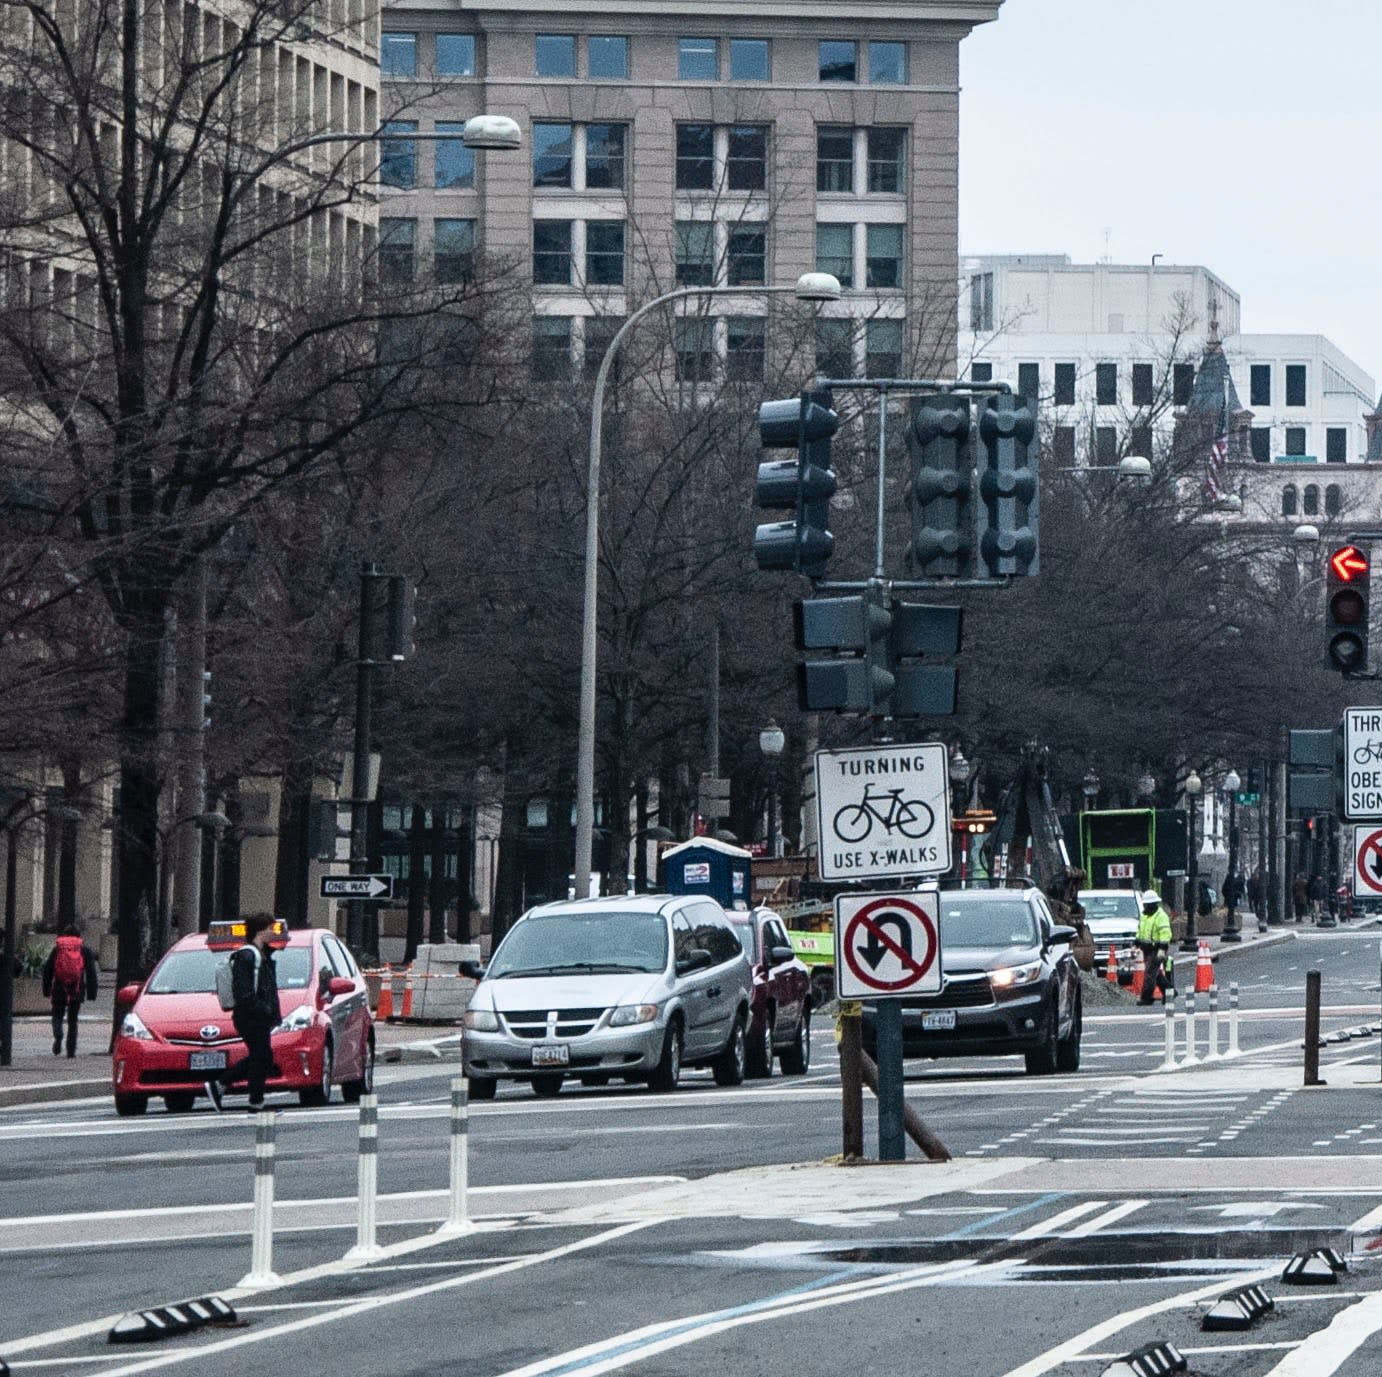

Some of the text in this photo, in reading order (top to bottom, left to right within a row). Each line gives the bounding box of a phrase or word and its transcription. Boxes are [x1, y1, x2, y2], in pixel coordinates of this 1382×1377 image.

[839, 756, 925, 776] TURNING
[834, 847, 937, 868] USE X-WALKS
[327, 882, 370, 891] ONE WAY
